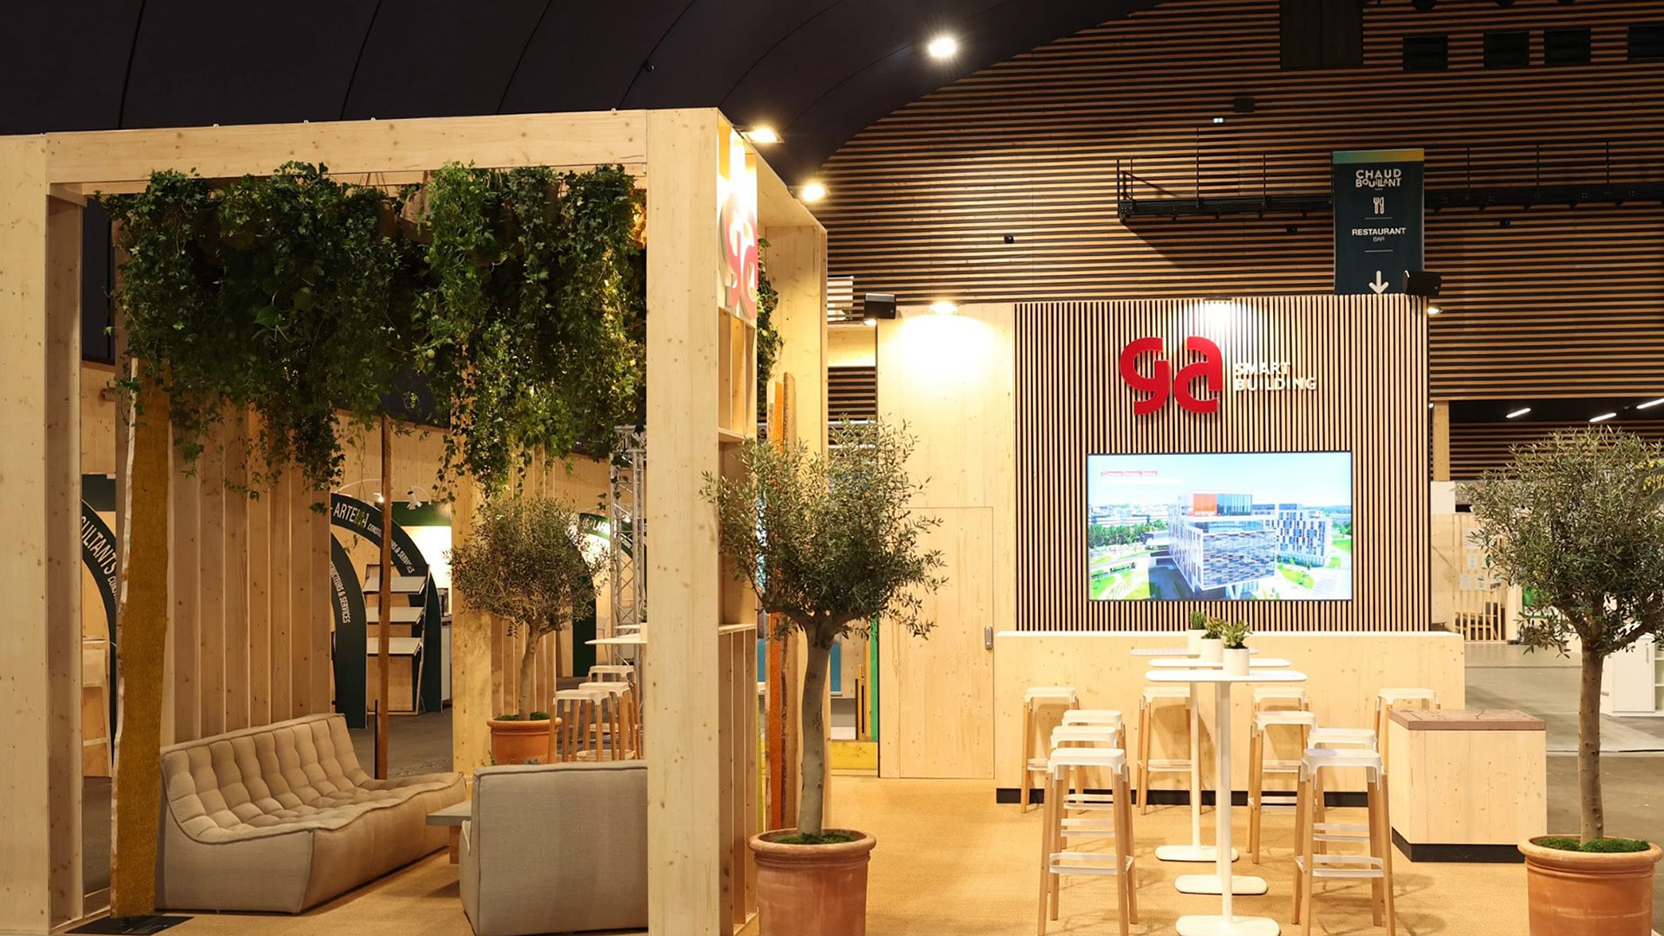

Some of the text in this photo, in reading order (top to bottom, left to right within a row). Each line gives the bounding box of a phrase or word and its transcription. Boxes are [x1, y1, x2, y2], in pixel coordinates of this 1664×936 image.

[1355, 169, 1402, 179] CHAUD
[1351, 227, 1406, 236] RESTAURANT
[1234, 361, 1291, 376] SMART
[1234, 377, 1318, 392] BUILDING
[333, 502, 370, 529] ARTEA
